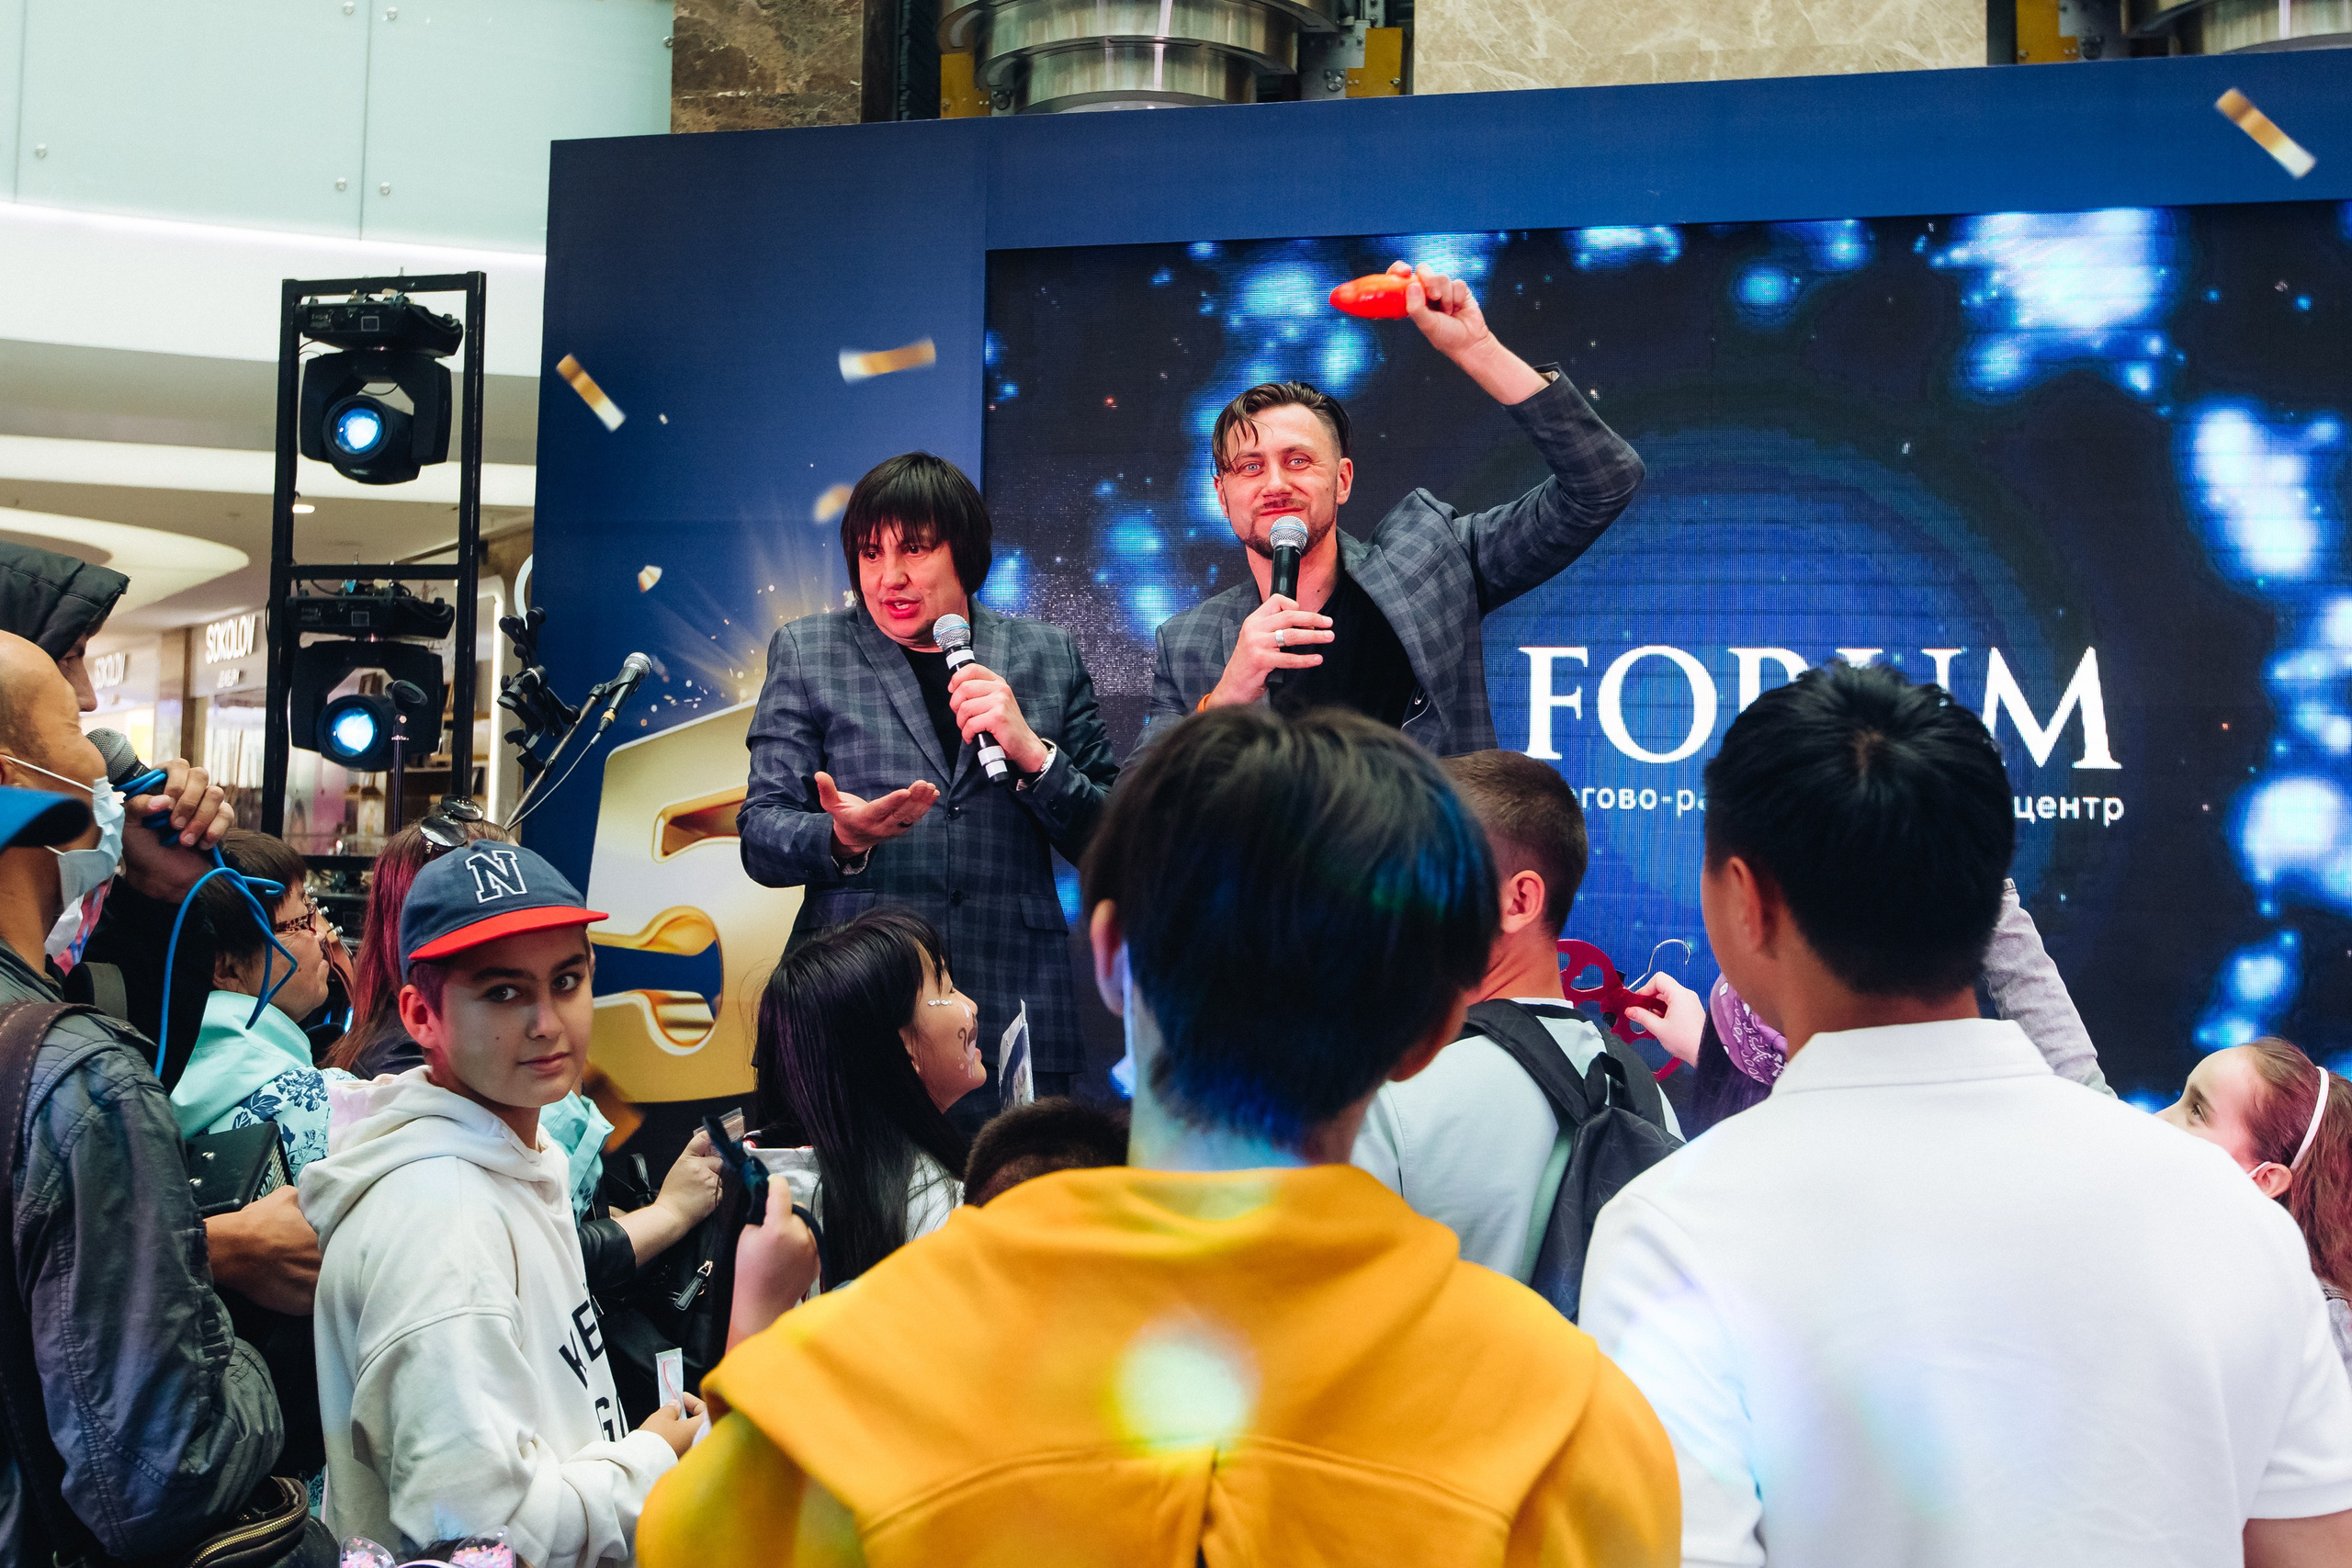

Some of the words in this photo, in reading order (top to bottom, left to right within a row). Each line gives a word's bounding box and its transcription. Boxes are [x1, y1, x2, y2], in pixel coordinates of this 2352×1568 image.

[205, 614, 255, 665] SOKOLOV
[1518, 645, 2123, 770] FOM
[2013, 795, 2125, 829] центр
[465, 850, 528, 904] N
[558, 1283, 605, 1391] KE
